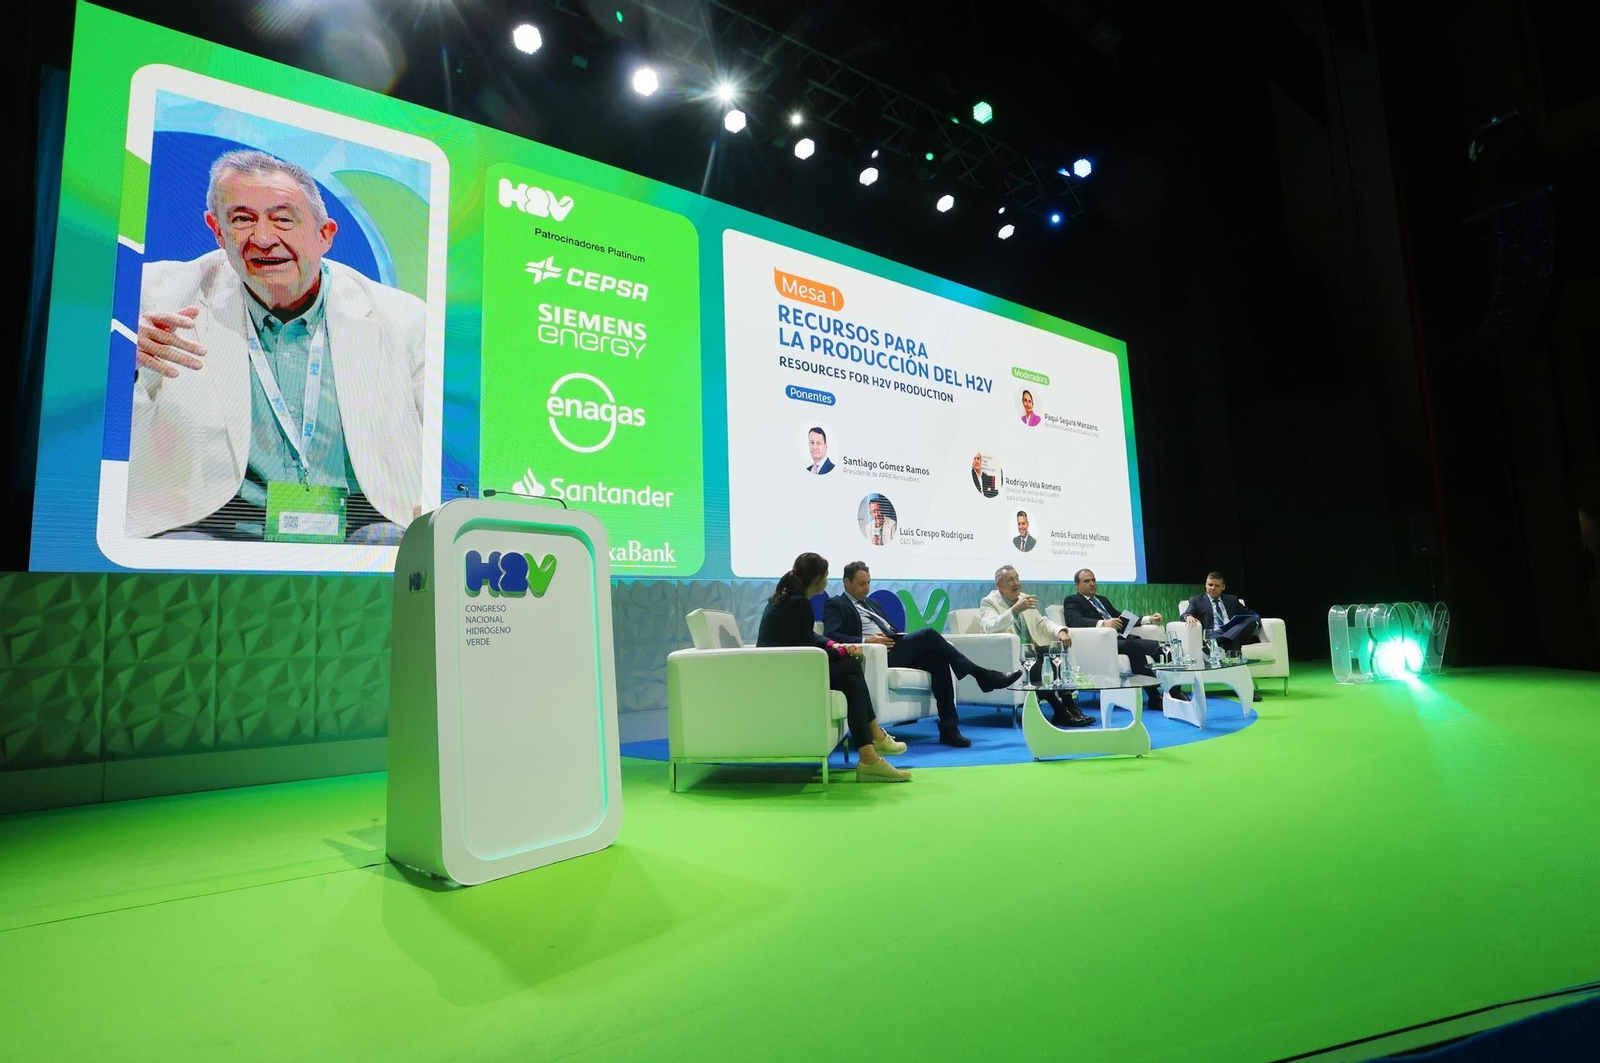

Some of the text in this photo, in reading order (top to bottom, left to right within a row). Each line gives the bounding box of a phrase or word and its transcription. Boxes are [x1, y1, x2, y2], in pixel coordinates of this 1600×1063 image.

[534, 227, 646, 263] Patrocinadores Platinum
[566, 267, 649, 301] CEPSA
[781, 276, 836, 307] Mesa 1
[538, 303, 647, 341] SIEMENS
[778, 304, 928, 359] RECURSOS PARA
[779, 327, 993, 394] LA PRODUCCIÓN DEL H2V
[779, 356, 954, 403] RESOURCES FOR H2V PRODUCTION
[790, 387, 832, 404] Ponentes
[843, 456, 930, 476] Santiago Gómez Ramos
[550, 477, 674, 508] Santander
[1006, 477, 1028, 489] Rodrigo
[899, 527, 914, 536] Luis
[915, 528, 939, 539] Crespo
[1068, 531, 1088, 540] Fuentes
[609, 540, 677, 562] xaBank
[465, 550, 558, 597] H2V
[465, 605, 507, 613] CONGRESO
[466, 625, 511, 635] HIDRÓGENO
[466, 638, 490, 646] VERDE
